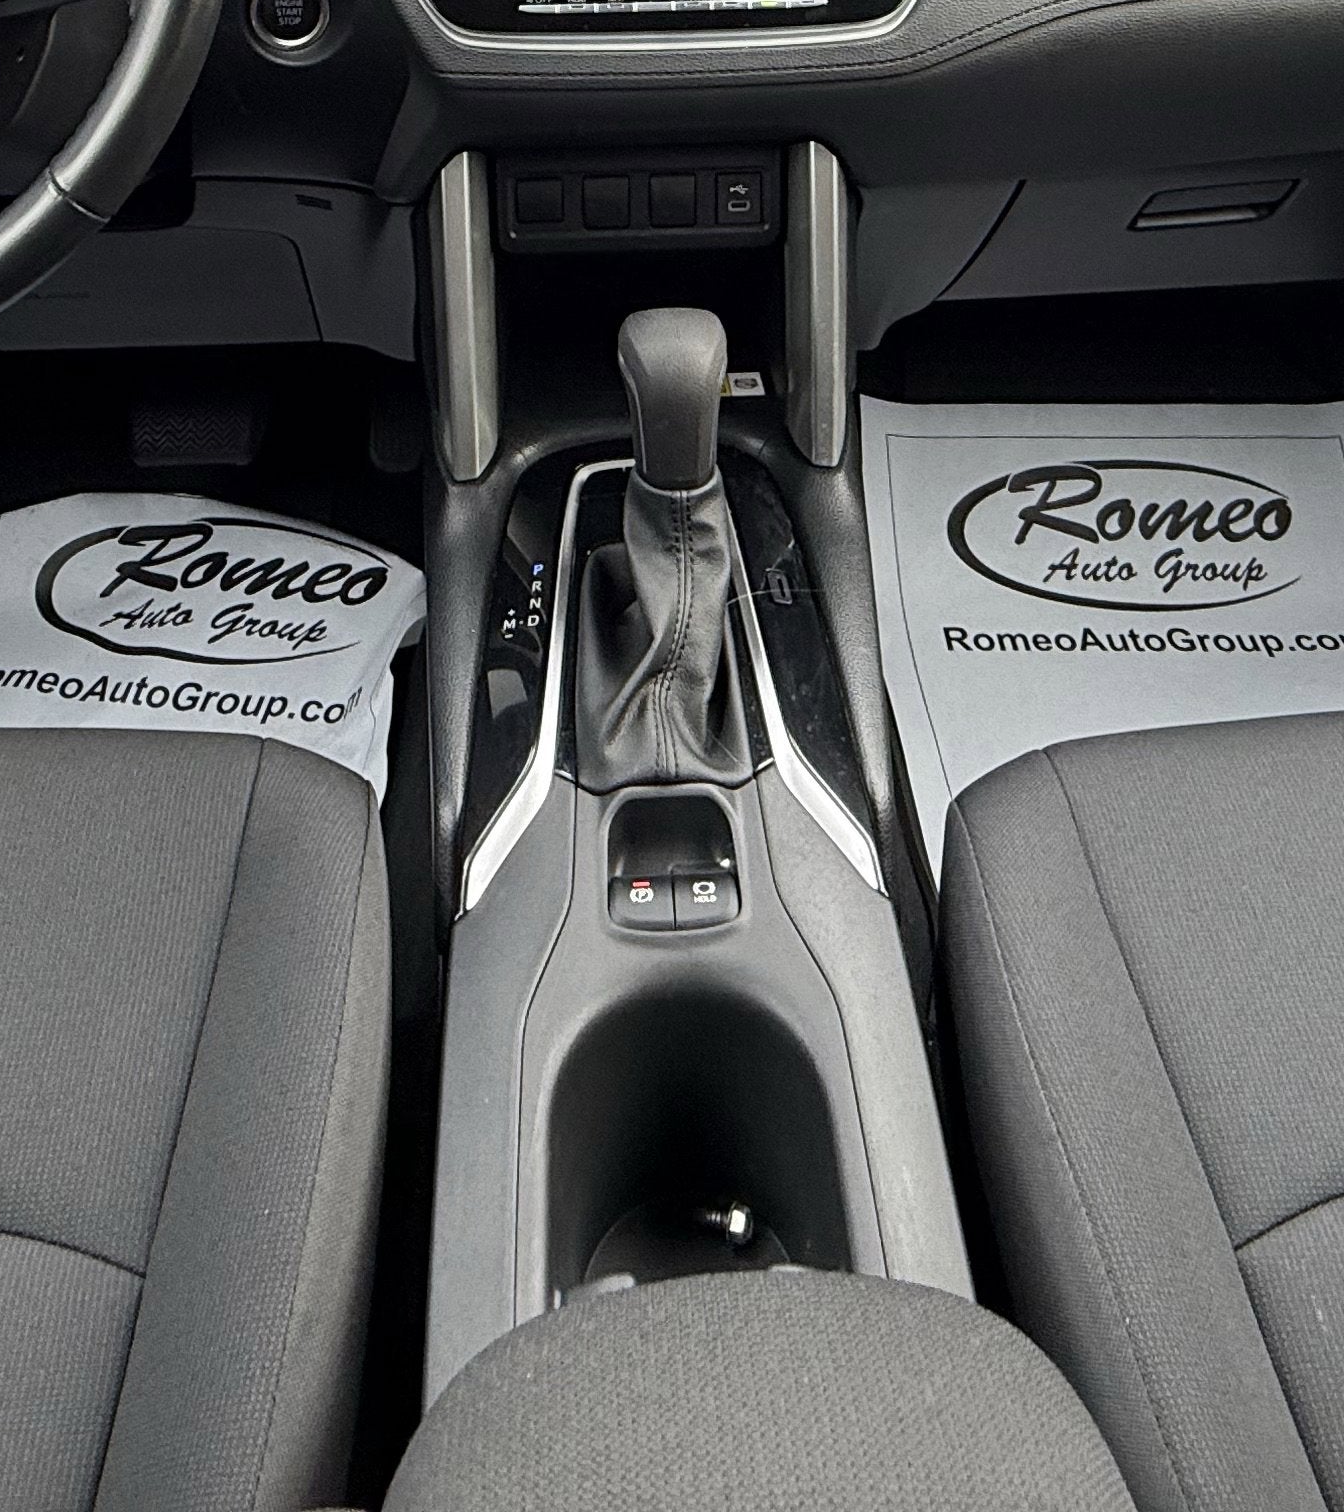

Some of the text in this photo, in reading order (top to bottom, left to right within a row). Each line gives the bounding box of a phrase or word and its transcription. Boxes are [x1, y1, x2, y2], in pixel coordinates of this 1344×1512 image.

[276, 8, 303, 17] START
[278, 17, 302, 25] STOP
[1008, 463, 1293, 545] Romeo
[99, 521, 389, 606] Romeo
[533, 563, 544, 576] P
[1043, 548, 1269, 593] Auto Group
[532, 580, 543, 593] R
[529, 597, 541, 610] N
[99, 598, 329, 651] Auto Group
[503, 614, 540, 631] M D
[694, 895, 717, 903] HOLD
